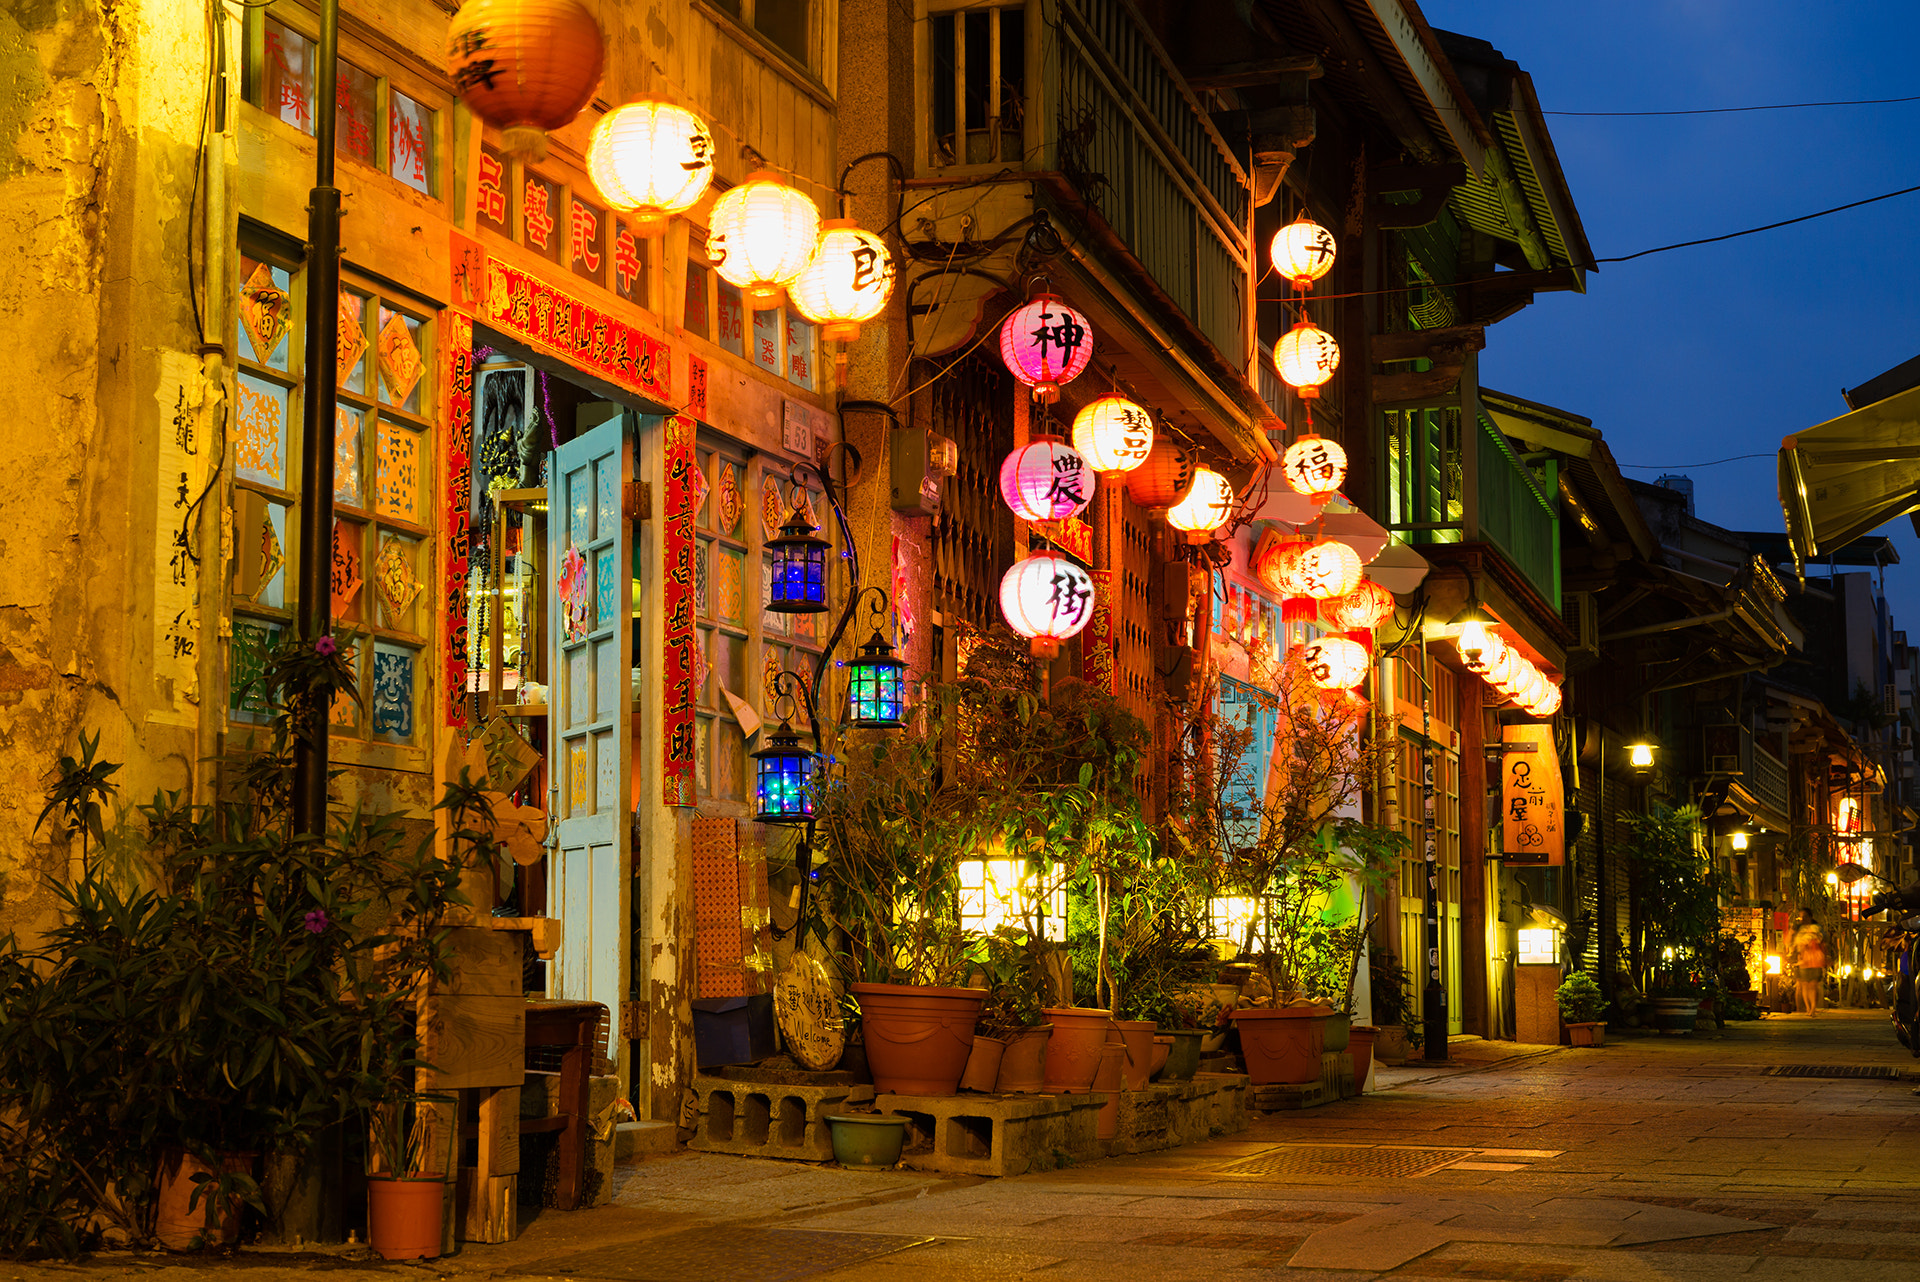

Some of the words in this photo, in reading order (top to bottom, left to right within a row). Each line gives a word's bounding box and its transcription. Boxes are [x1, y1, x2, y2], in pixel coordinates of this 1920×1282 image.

[1030, 312, 1085, 368] 神
[794, 425, 808, 451] 53
[1113, 408, 1153, 460] 藝品
[1040, 453, 1087, 506] 農
[1295, 445, 1334, 482] 福
[1045, 569, 1091, 625] 街
